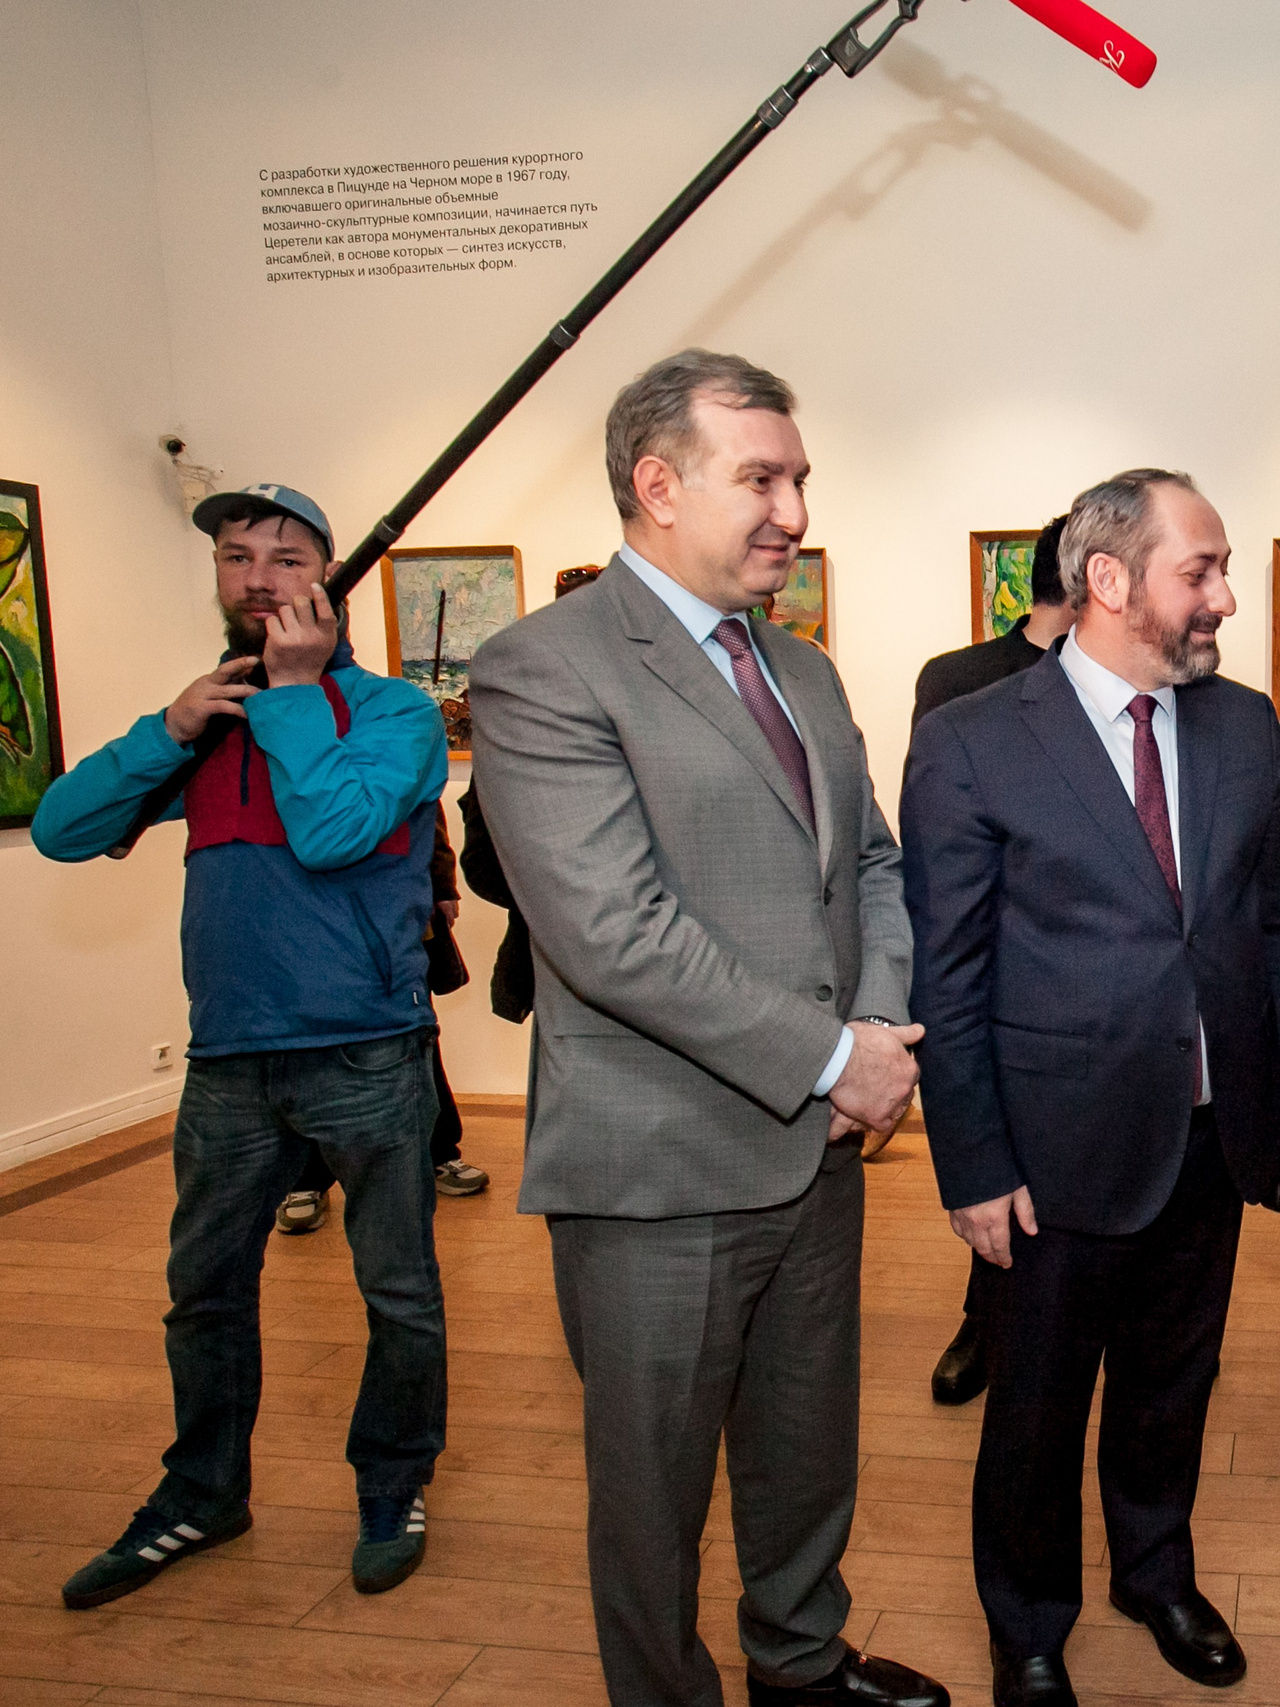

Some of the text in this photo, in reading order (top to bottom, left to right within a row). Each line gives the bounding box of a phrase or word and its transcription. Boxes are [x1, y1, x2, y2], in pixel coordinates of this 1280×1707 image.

[259, 152, 583, 182] С разработки художественного решения курортного
[261, 169, 570, 197] комплекса в Пицунде на Черном море в 1967 году,
[262, 192, 498, 214] включавшего оригинальные объемные
[263, 203, 598, 231] мозаично-скульптурные композиции, начинается путь
[264, 221, 588, 250] Церетели как автора монументальных декоративных
[266, 251, 334, 265] ансамблей,
[338, 252, 344, 260] в
[348, 250, 390, 260] основе
[394, 247, 443, 258] которых
[462, 242, 504, 254] синтез
[507, 239, 566, 250] искусств,
[267, 259, 516, 283] архитектурных и изобразительных форм.
